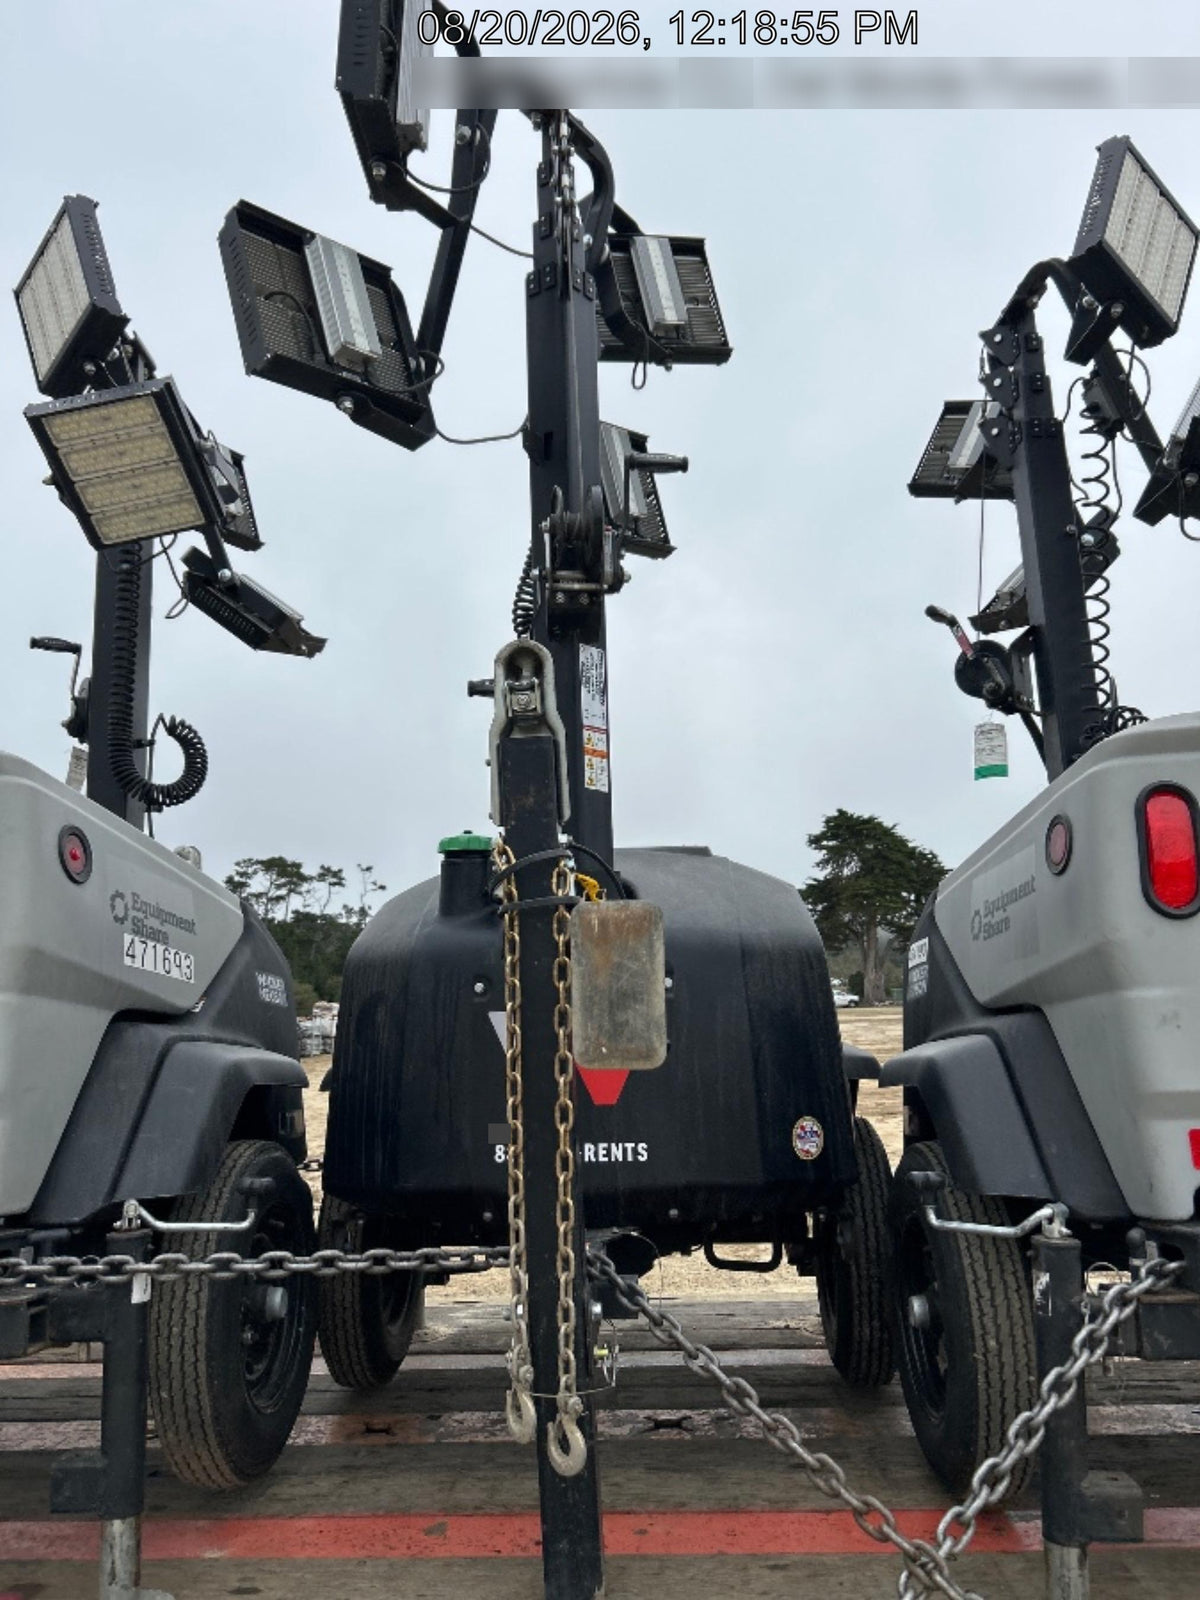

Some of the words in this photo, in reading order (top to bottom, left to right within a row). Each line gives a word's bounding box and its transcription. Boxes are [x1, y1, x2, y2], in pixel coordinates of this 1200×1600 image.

[130, 891, 197, 936] Equipment
[983, 874, 1036, 918] Equipment
[131, 915, 170, 946] Share
[982, 916, 1011, 942] Share
[125, 938, 193, 981] 471693
